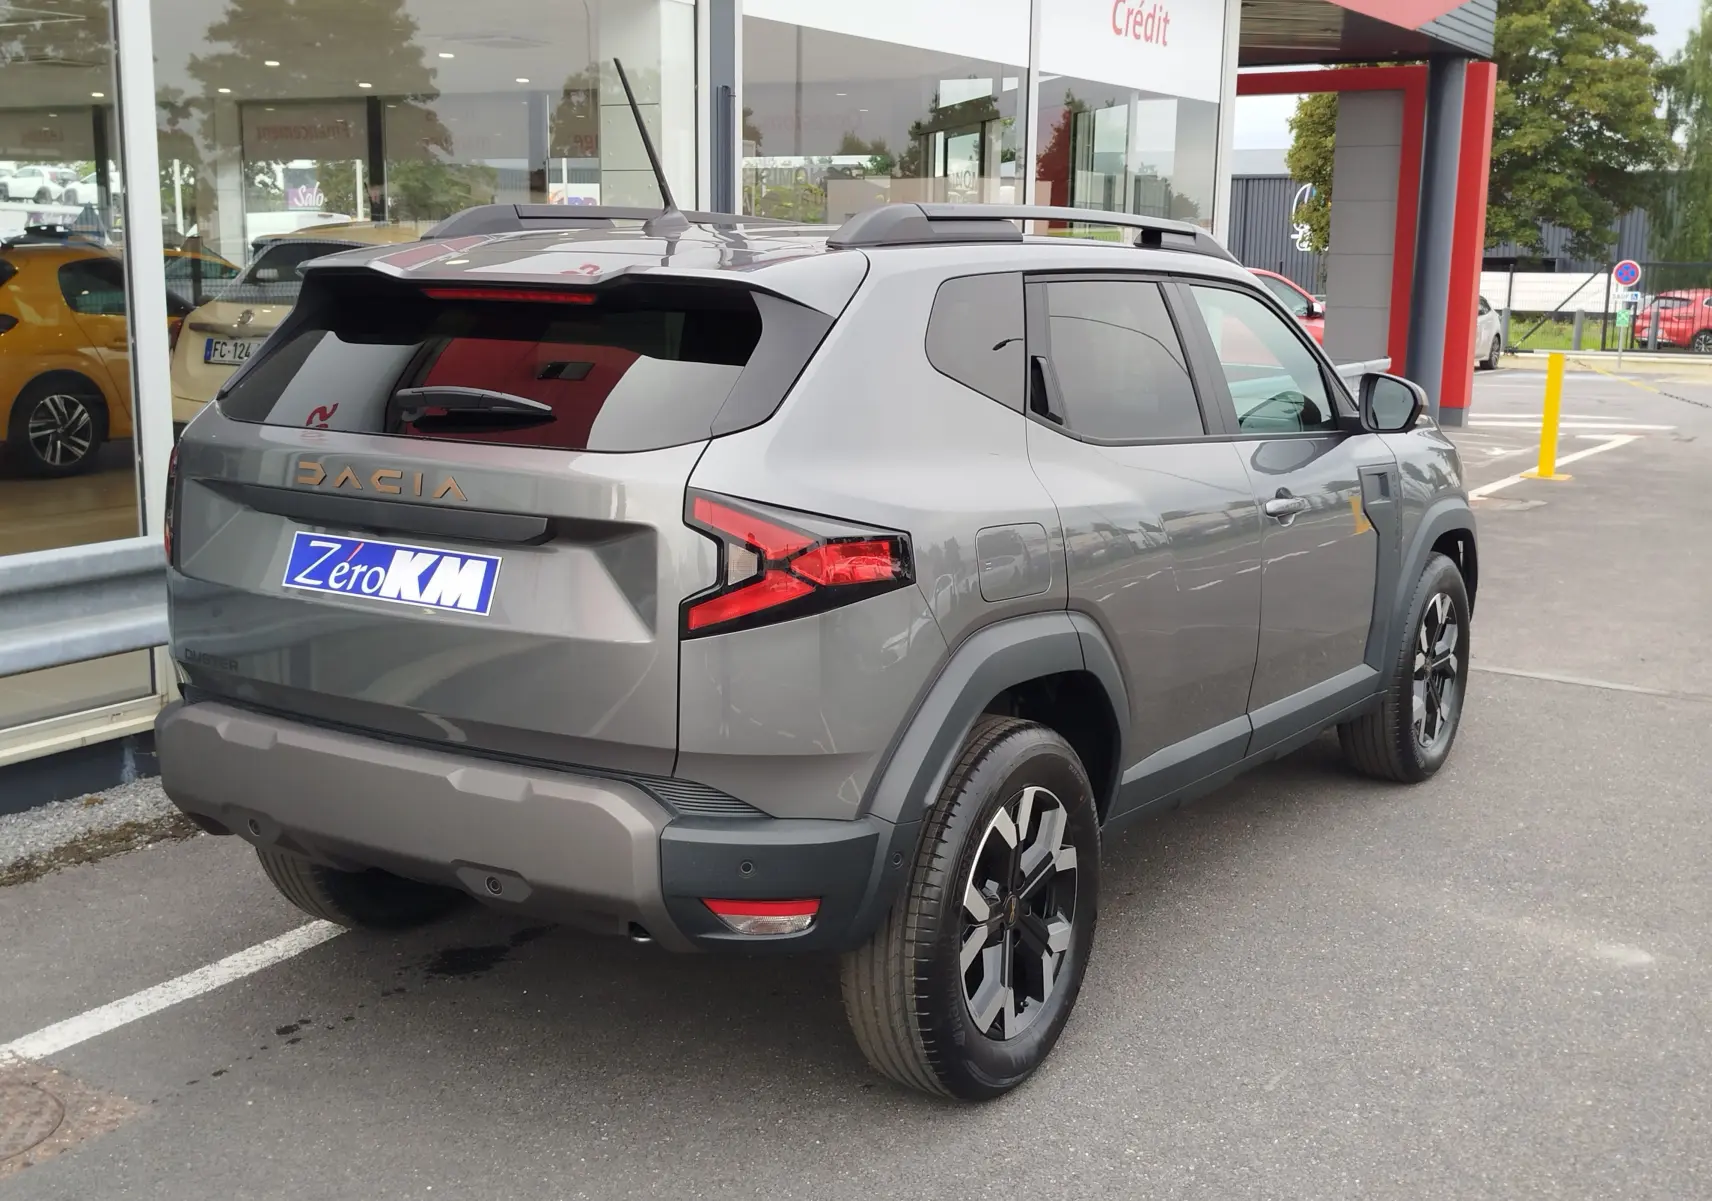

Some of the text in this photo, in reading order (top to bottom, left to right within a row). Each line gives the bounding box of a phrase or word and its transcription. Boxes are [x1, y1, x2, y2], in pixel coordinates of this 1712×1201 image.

[1112, 0, 1171, 47] Crédit
[297, 460, 468, 502] DACIA
[185, 647, 239, 673] DUSTER
